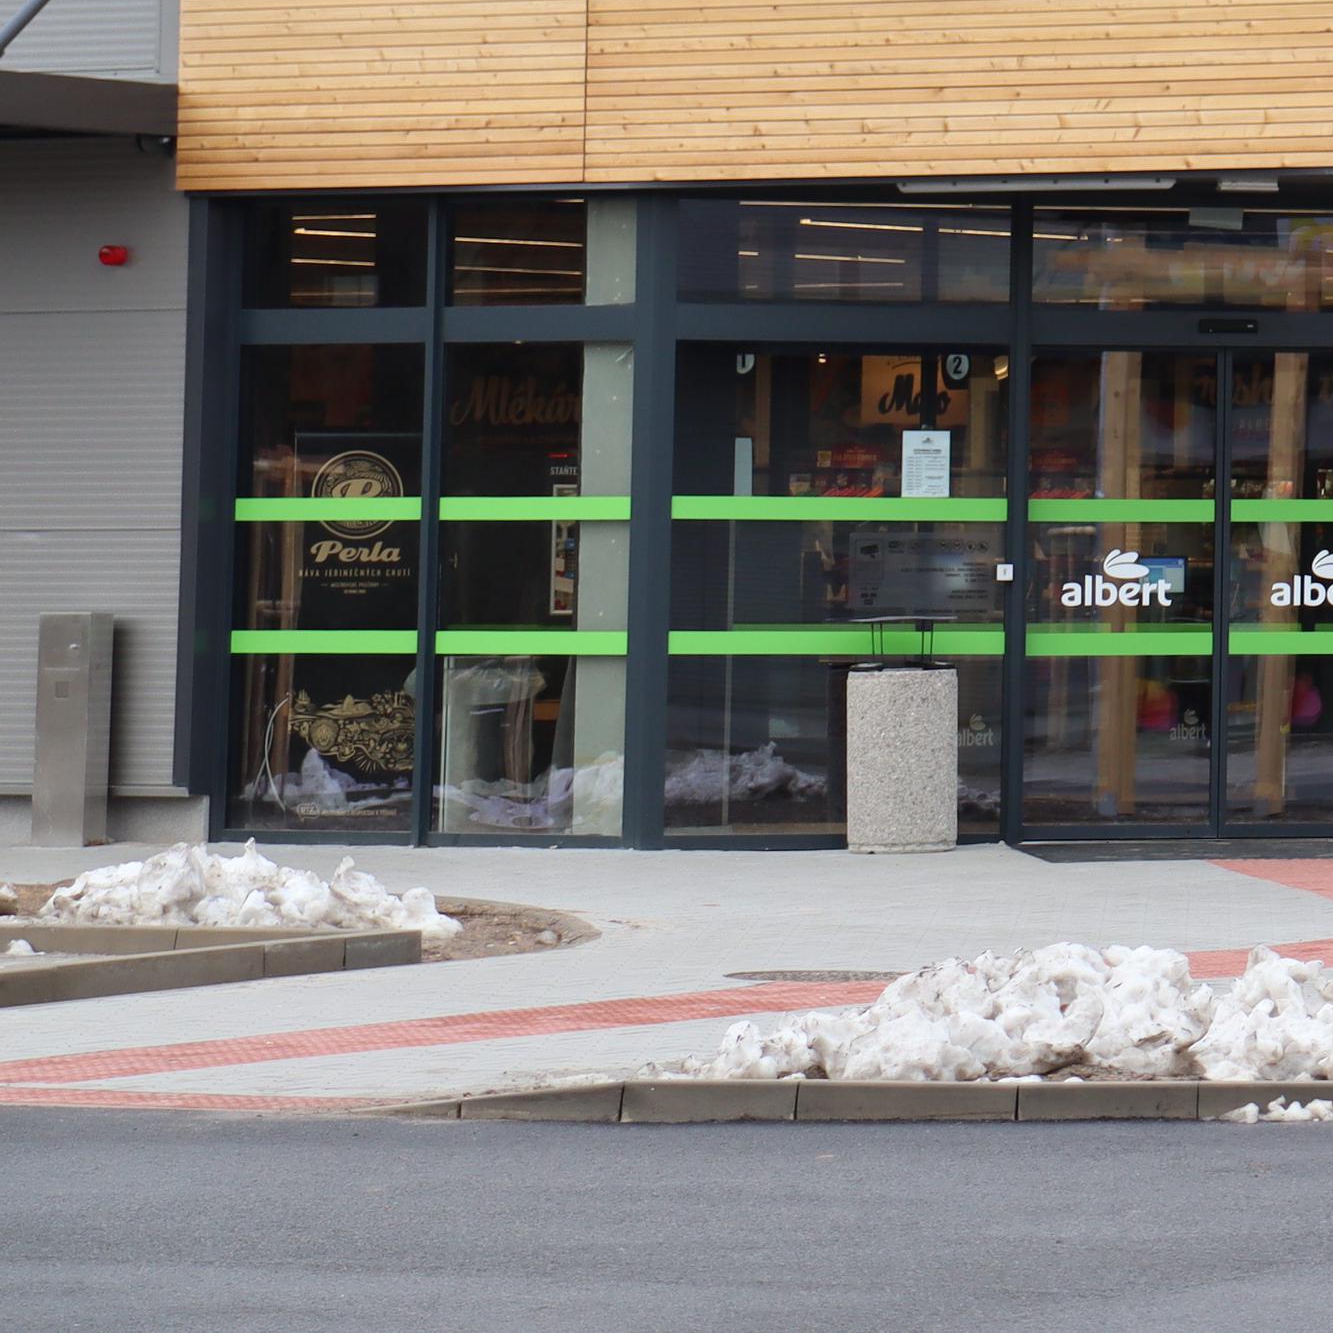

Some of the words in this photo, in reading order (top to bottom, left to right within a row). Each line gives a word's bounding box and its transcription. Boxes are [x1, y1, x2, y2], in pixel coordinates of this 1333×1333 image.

[952, 356, 963, 374] 2
[310, 540, 402, 563] Perla
[1061, 574, 1172, 607] albert
[1169, 722, 1207, 741] albert
